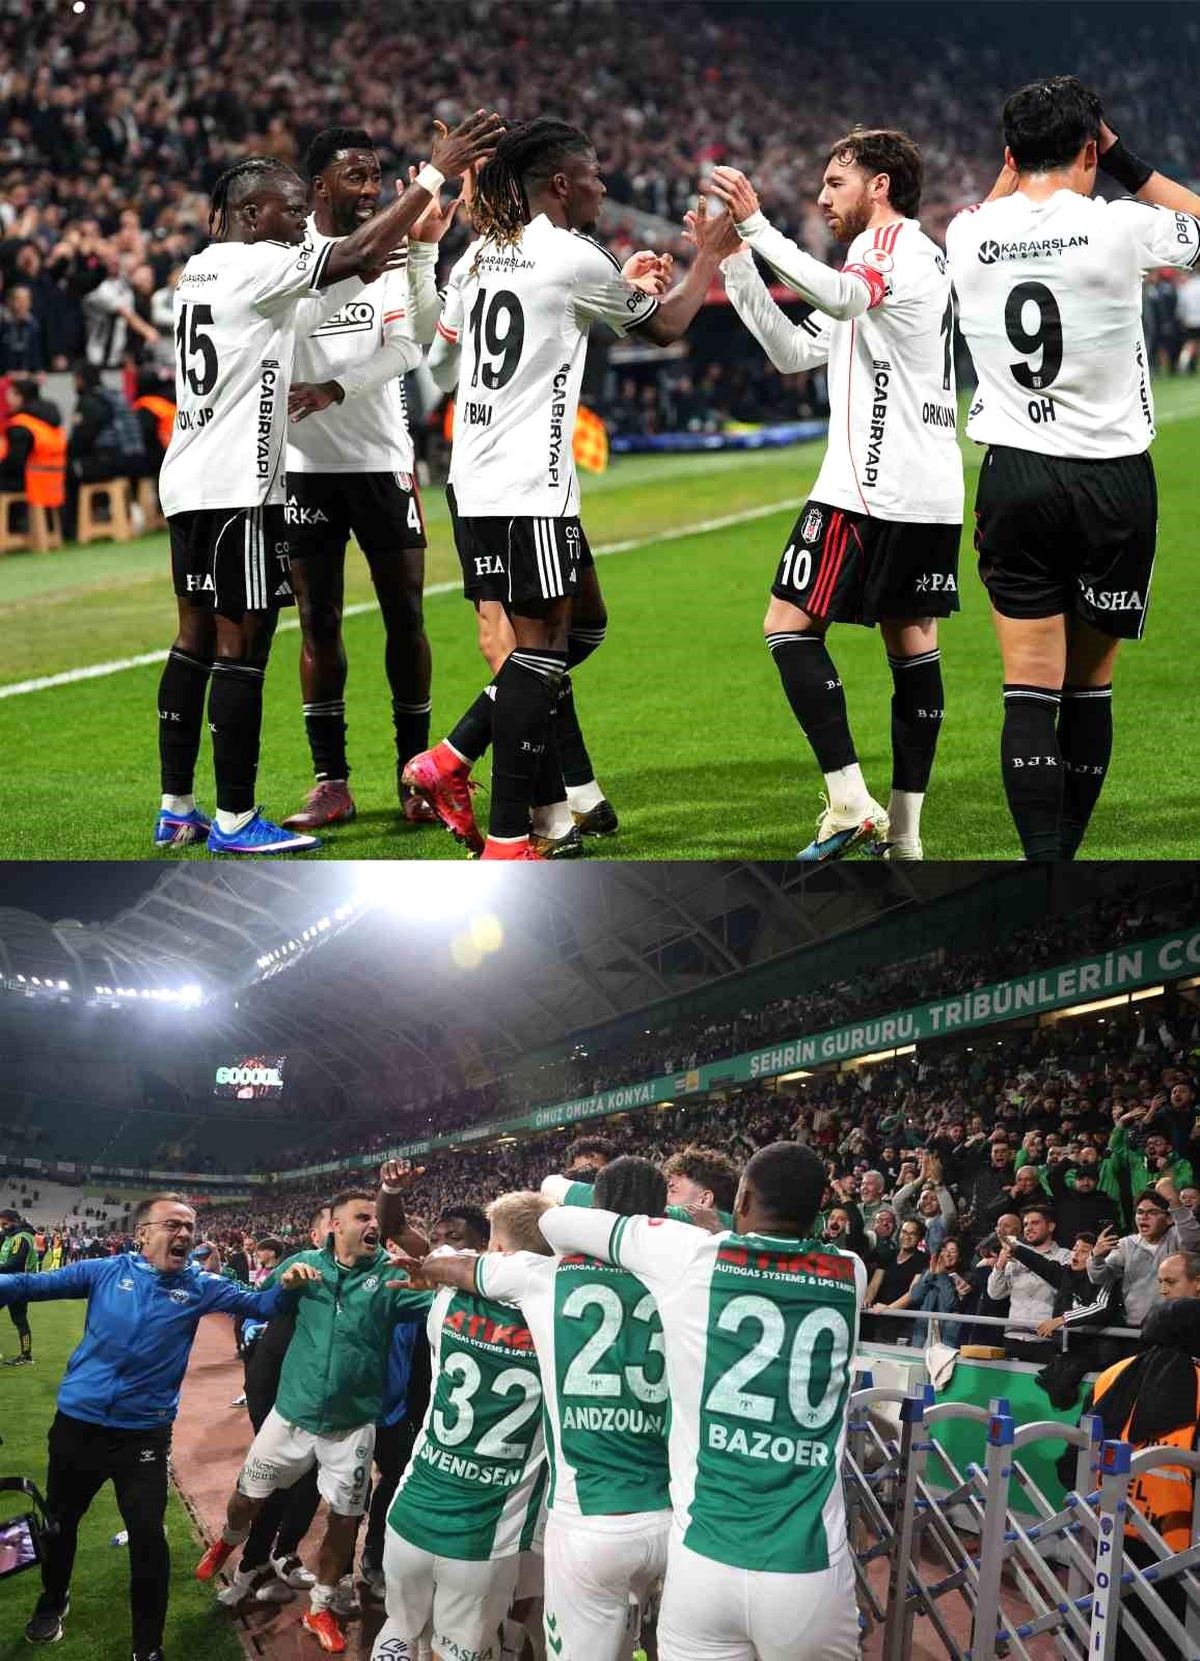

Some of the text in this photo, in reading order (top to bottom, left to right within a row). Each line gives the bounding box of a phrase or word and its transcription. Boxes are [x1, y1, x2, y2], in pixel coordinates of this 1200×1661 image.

[176, 303, 219, 396] 15
[469, 287, 525, 390] 19
[1004, 281, 1063, 390] 9
[922, 402, 956, 428] ORKUN
[1028, 398, 1056, 424] OH
[406, 497, 421, 535] 4
[781, 544, 812, 590] 10
[930, 573, 957, 592] PA
[750, 1037, 815, 1078] ŞEHRİN
[930, 950, 1143, 1030] TRİBÜNLERİN
[761, 1270, 806, 1284] SYSTEMS
[562, 1284, 669, 1403] 23
[705, 1294, 850, 1429] 20
[433, 1352, 542, 1460] 32
[708, 1423, 829, 1467] BAZOER
